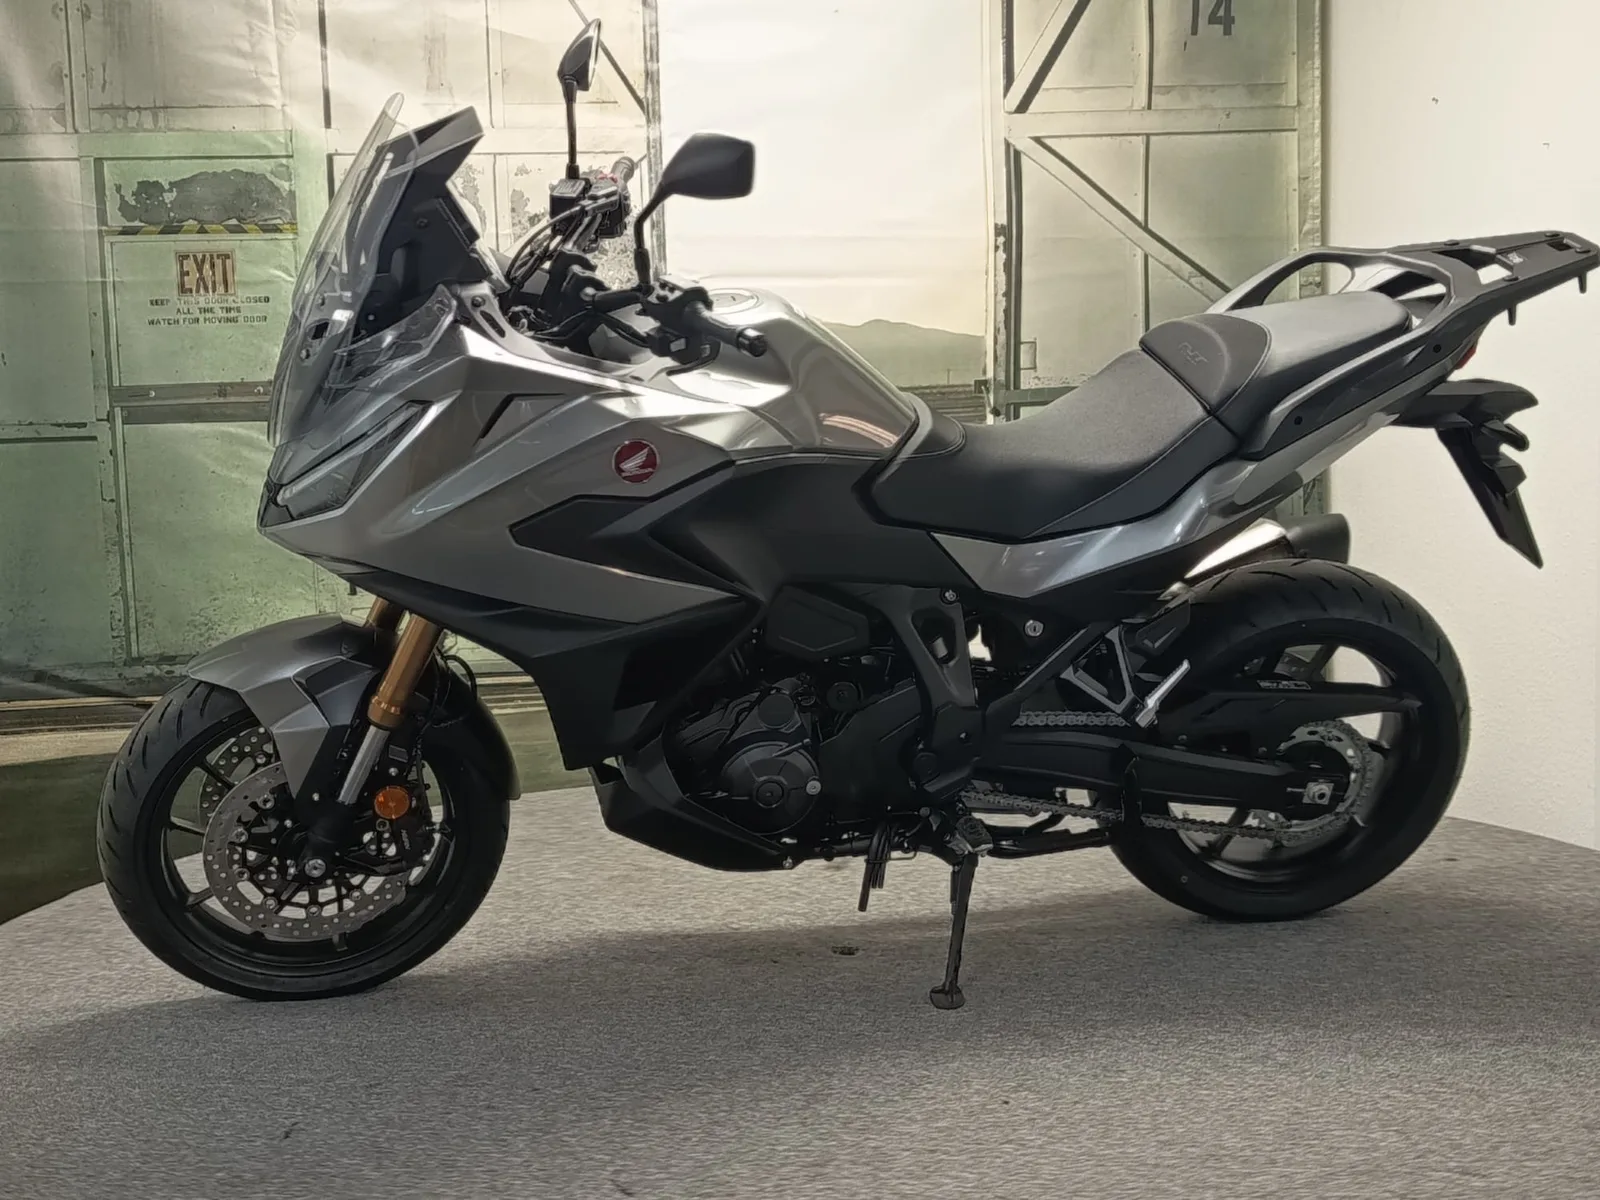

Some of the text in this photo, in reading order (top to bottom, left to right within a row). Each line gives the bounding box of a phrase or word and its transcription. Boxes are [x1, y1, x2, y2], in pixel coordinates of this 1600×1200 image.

[178, 253, 231, 294] EXIT
[232, 295, 270, 304] CLOSED
[176, 306, 242, 315] ALL THE TIME
[147, 315, 268, 326] WATCH FOR MOVING DOOR
